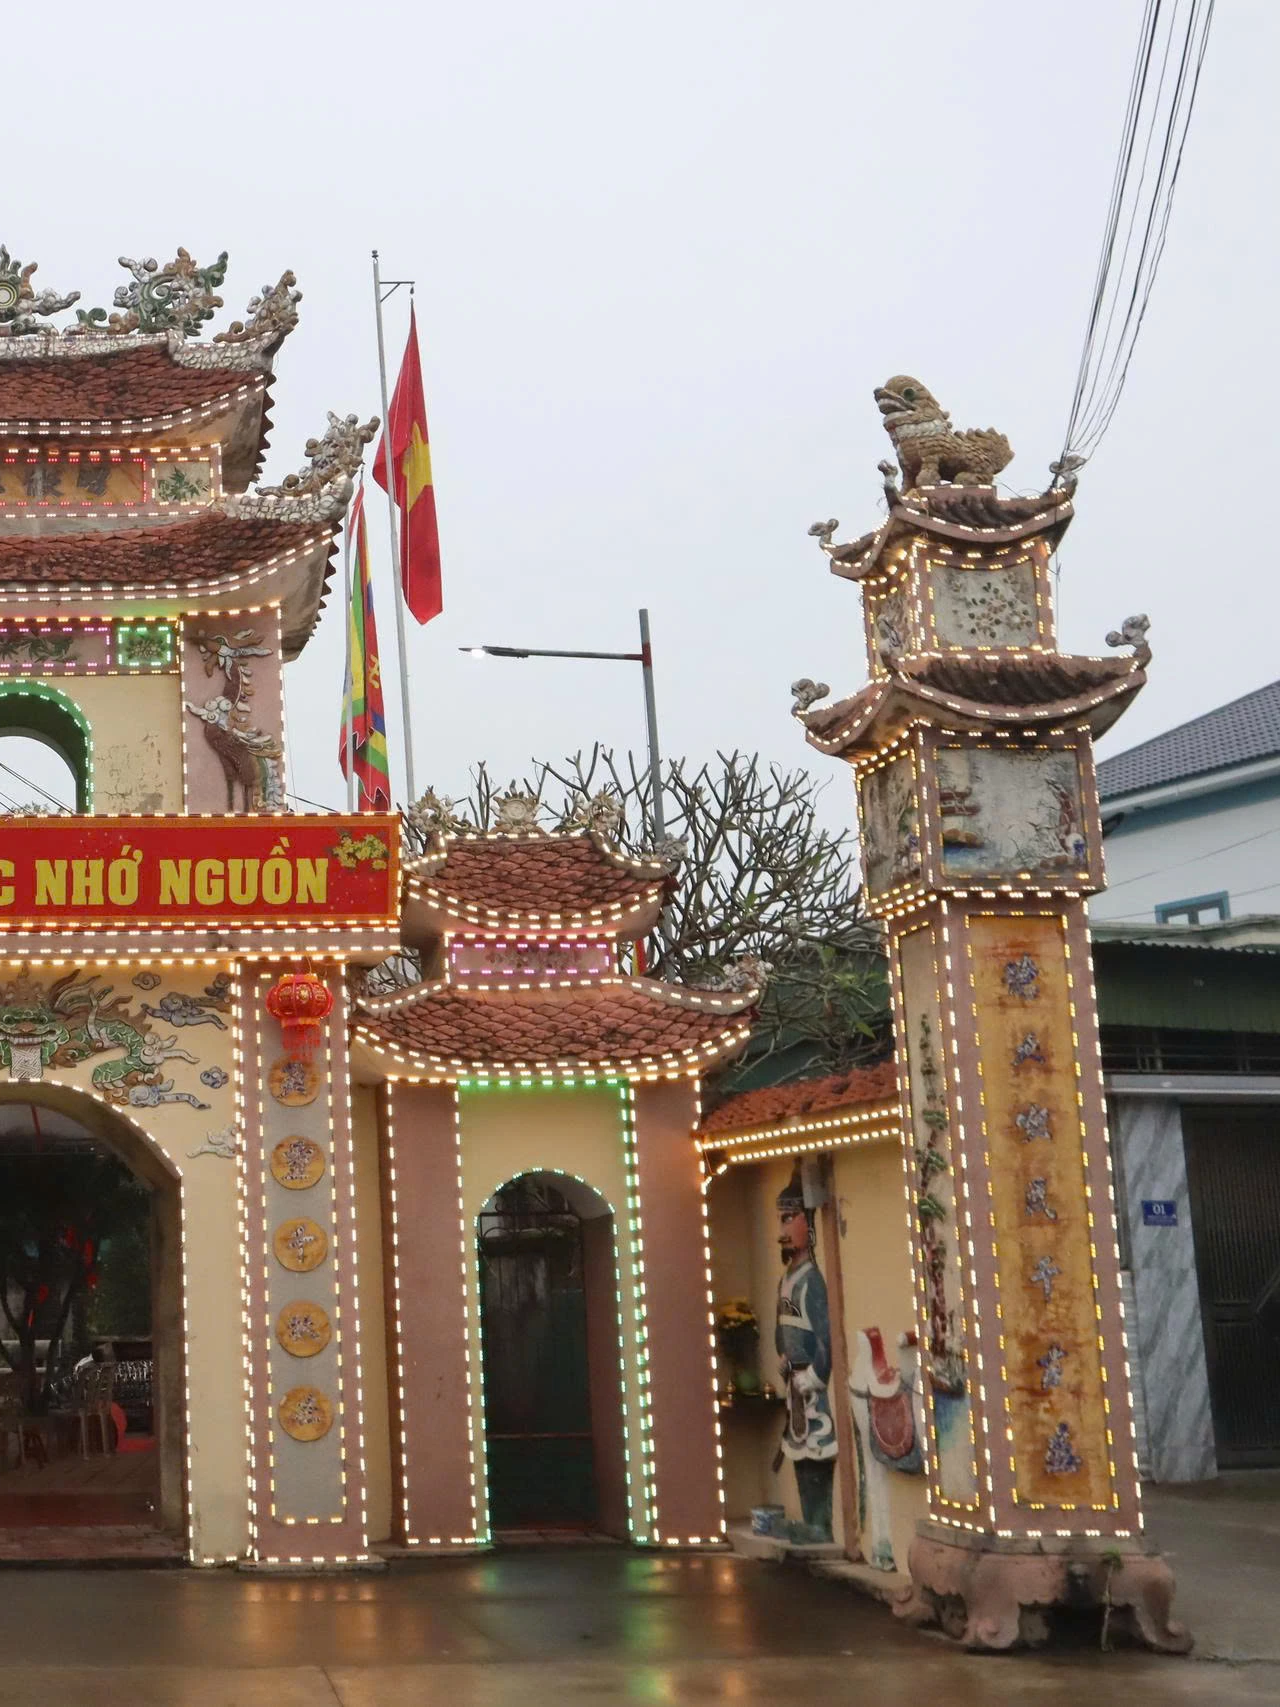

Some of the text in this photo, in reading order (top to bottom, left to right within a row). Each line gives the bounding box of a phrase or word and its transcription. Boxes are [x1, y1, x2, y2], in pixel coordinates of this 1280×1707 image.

[36, 845, 143, 906] NHỚ
[159, 836, 329, 905] NGUỒN
[1152, 1203, 1166, 1216] 01
